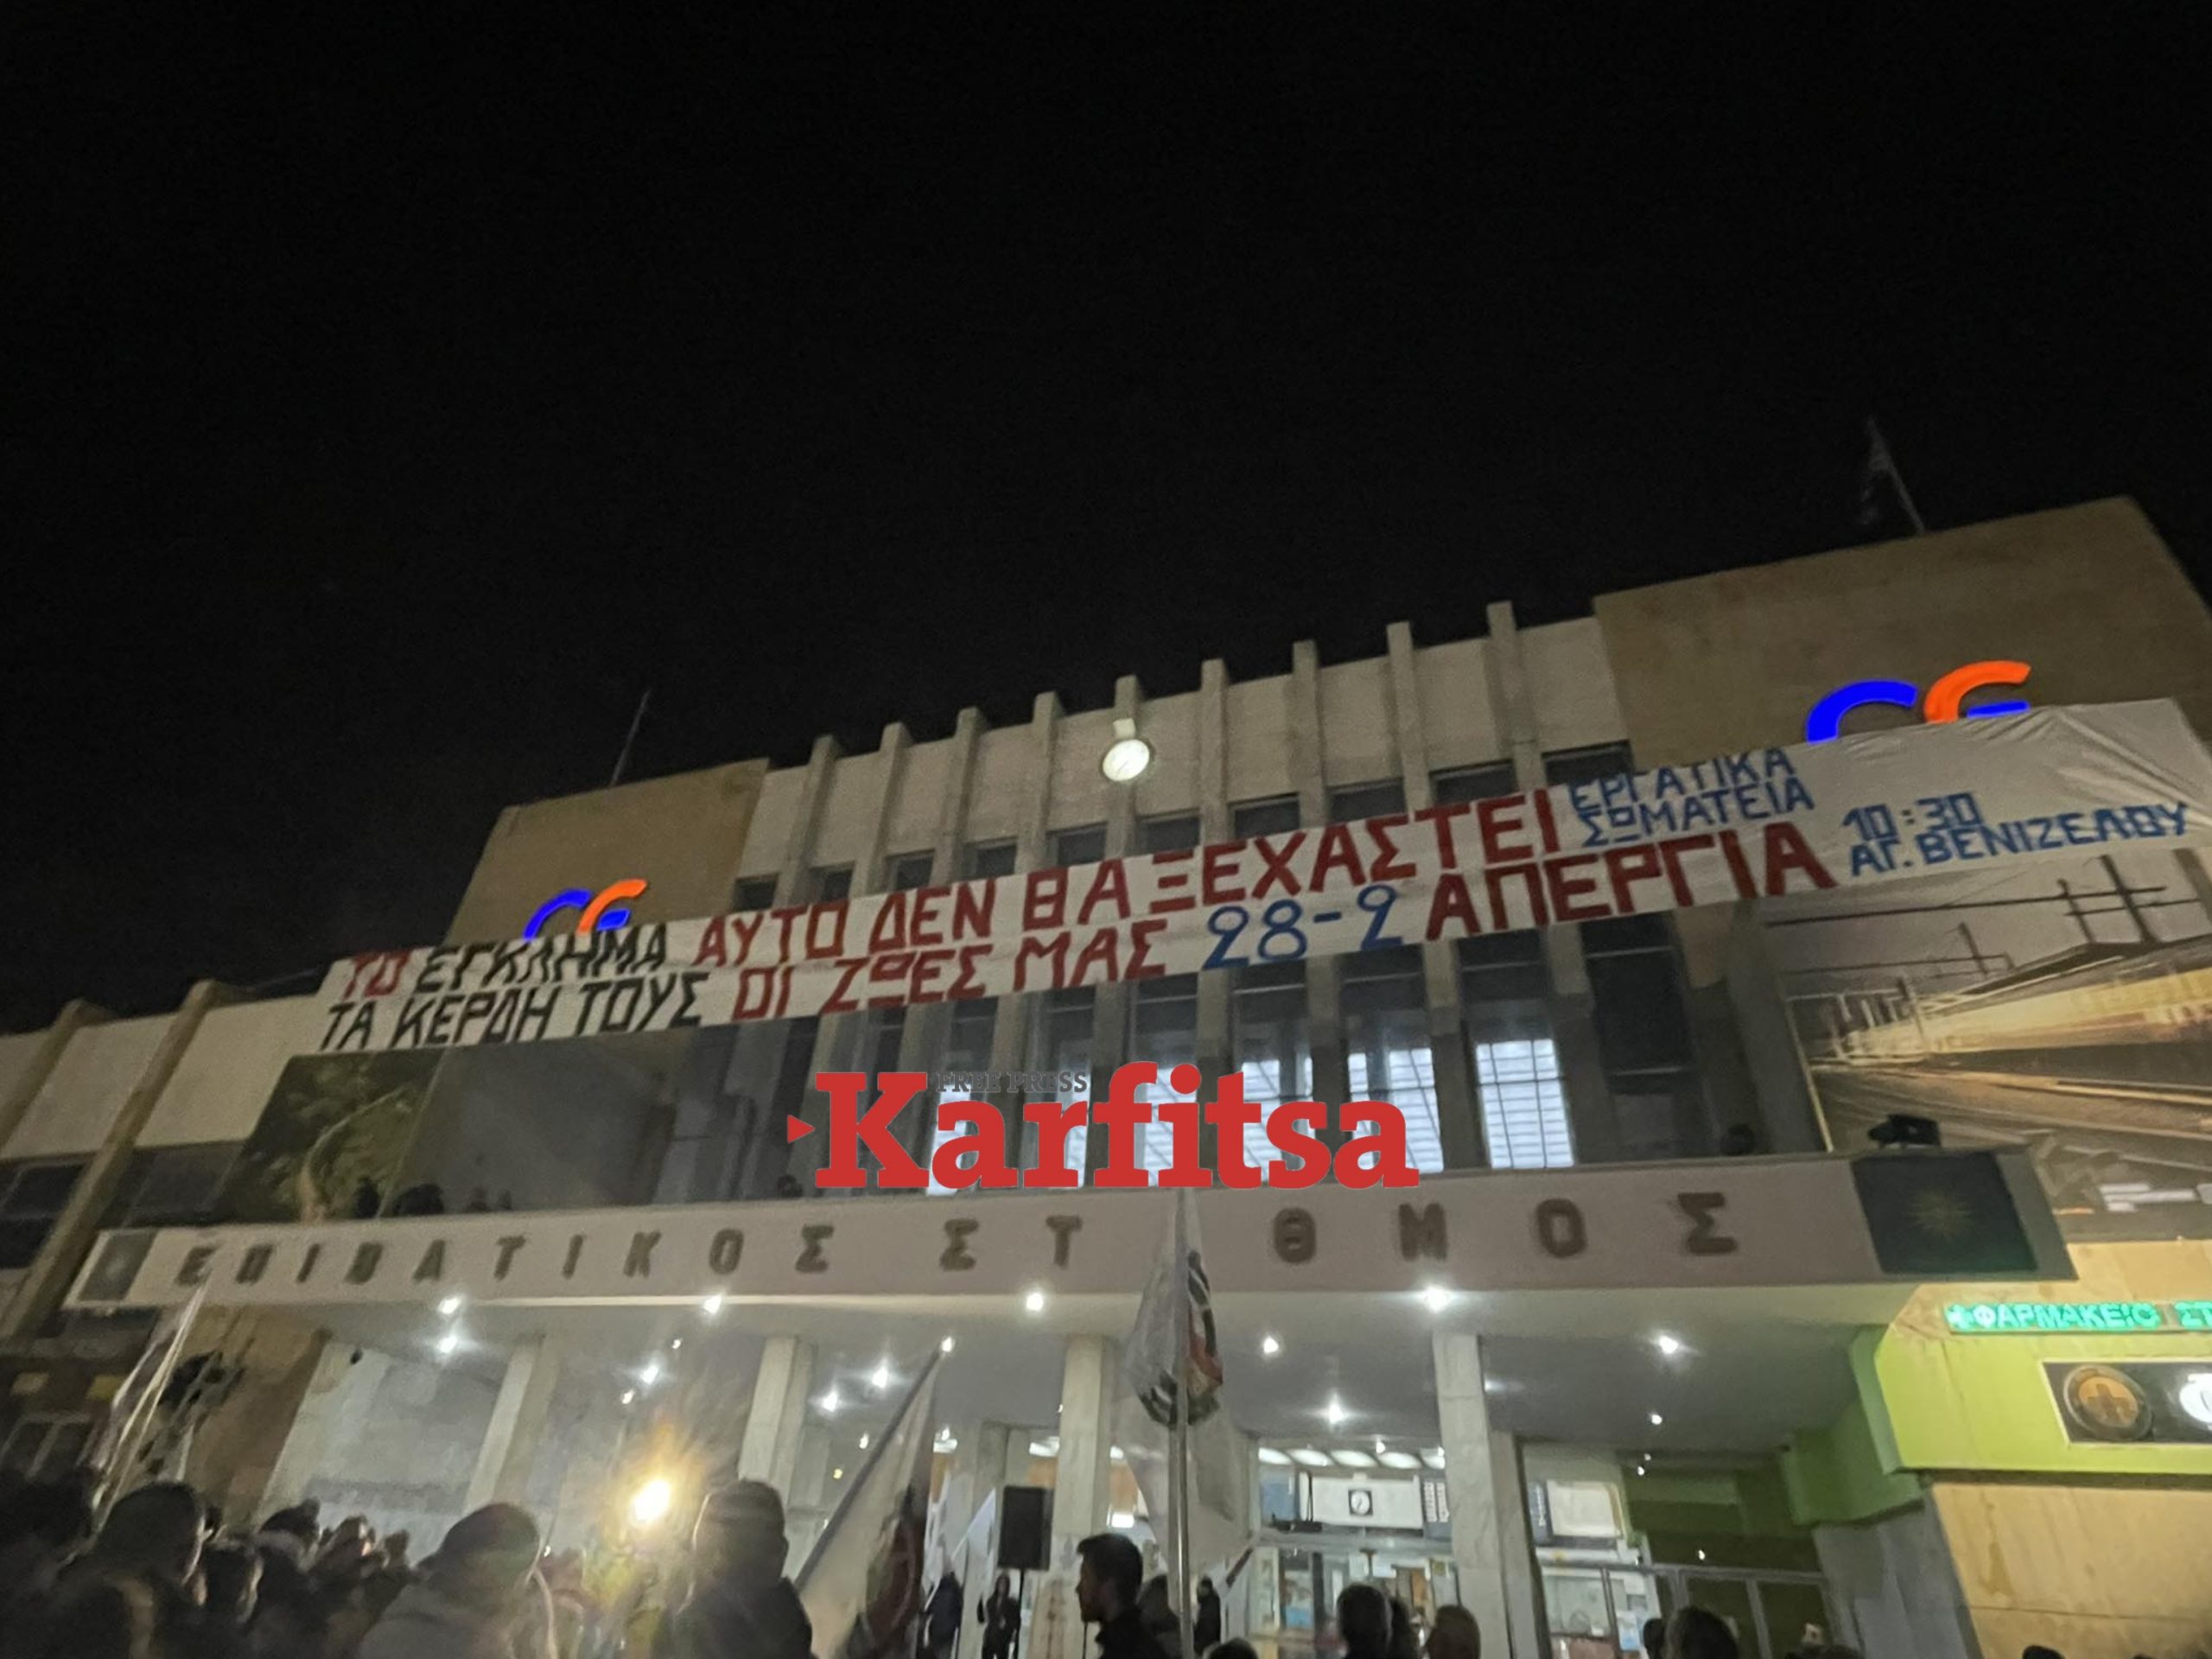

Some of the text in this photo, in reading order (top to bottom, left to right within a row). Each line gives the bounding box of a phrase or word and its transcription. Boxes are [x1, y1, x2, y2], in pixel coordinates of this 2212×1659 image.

[1842, 791, 1984, 842] 10:30
[320, 1000, 376, 1052] ΤΑ
[388, 983, 560, 1049] ΚΕΡΔΗ
[577, 971, 710, 1036] ΤΟΥΣ
[731, 963, 796, 1021] ΟΙ
[1013, 918, 1167, 992] ΜΑΣ
[1203, 884, 1404, 971] 28-2
[1426, 822, 1837, 942] ΑΠΕΡΓΙΑ
[345, 947, 411, 1000] ΤΟ
[413, 921, 667, 994] ΕΓΚΛΗΜΑ
[693, 899, 850, 968] ΑΥΤΟ
[868, 877, 997, 953] ΔΕΝ
[1023, 858, 1131, 931] ΘΑ
[1149, 788, 1560, 913] ΞΕΧΑΣΤΕΙ
[1973, 1302, 2160, 1329] ΦΑΡΜΑΚΕΙΟ
